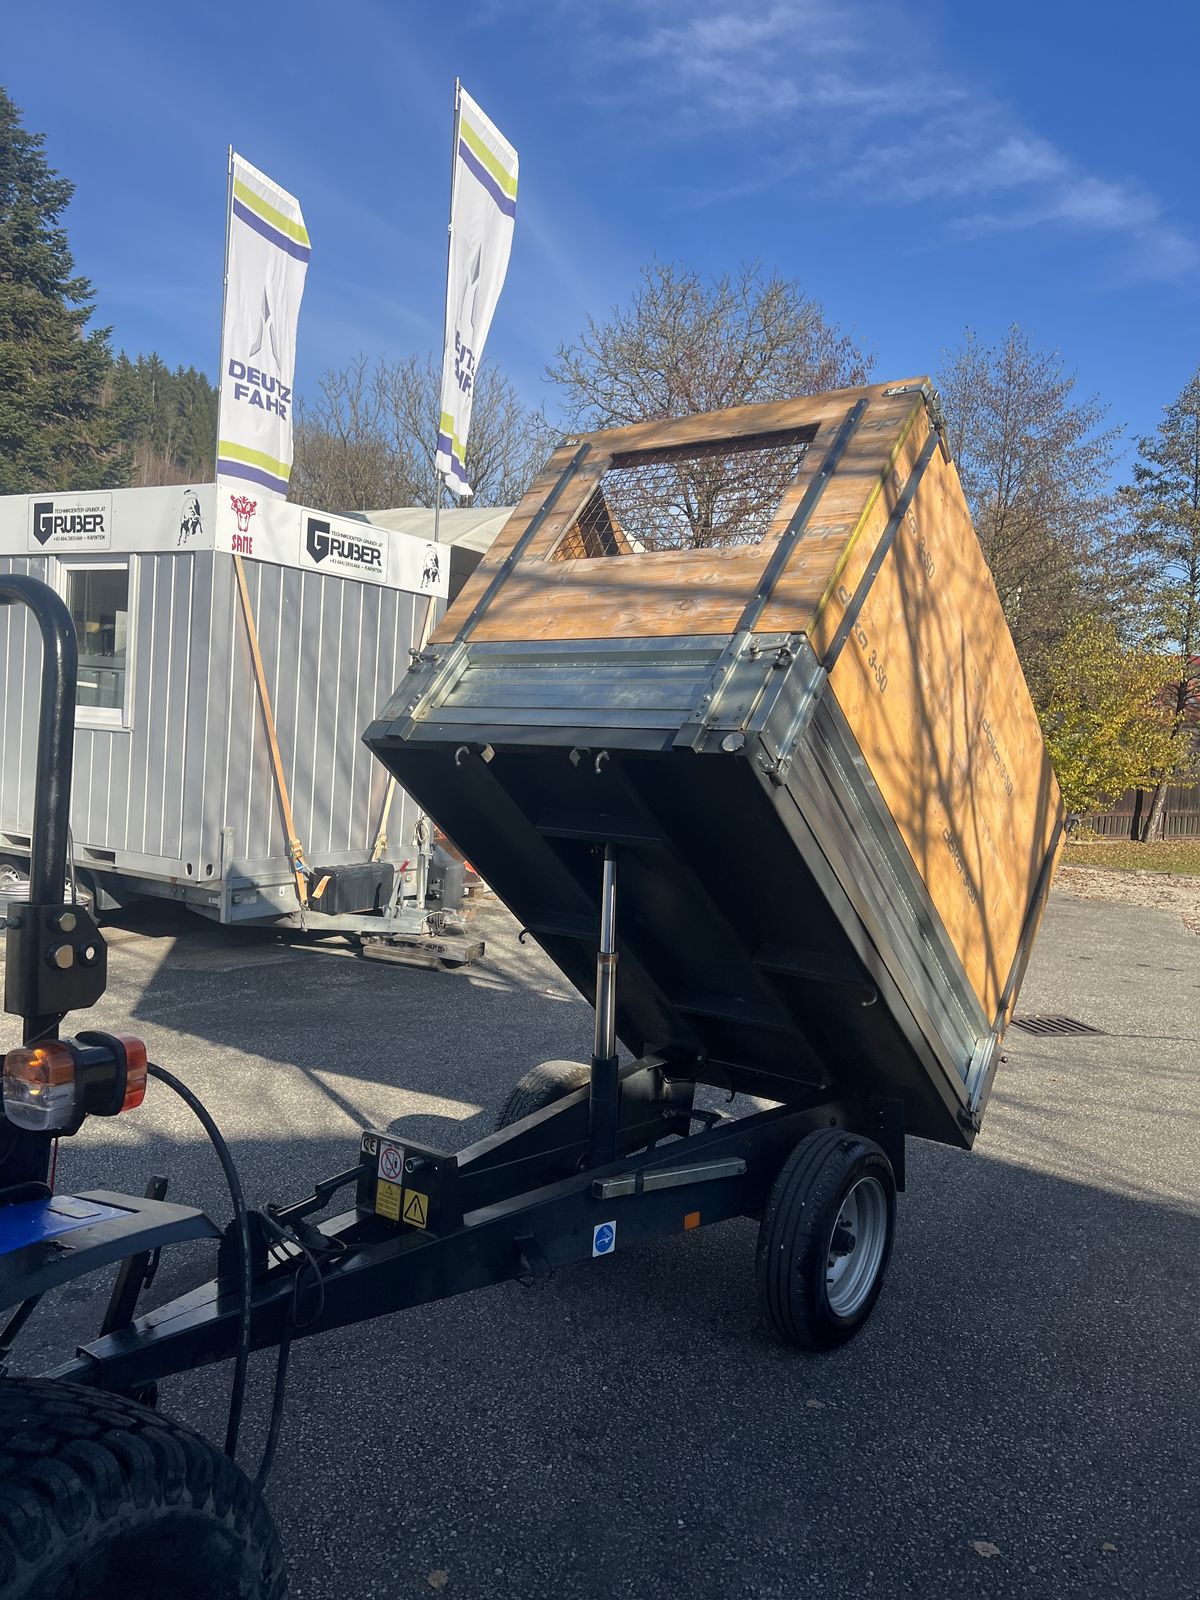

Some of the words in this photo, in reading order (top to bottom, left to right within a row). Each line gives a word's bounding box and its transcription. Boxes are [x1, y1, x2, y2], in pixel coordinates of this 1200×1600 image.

[228, 358, 291, 404] DEUTZ
[234, 382, 286, 421] FAHR
[33, 502, 105, 546] GRUBER
[231, 533, 253, 555] SAME
[306, 517, 382, 567] GRUBER
[364, 1137, 375, 1152] CE
